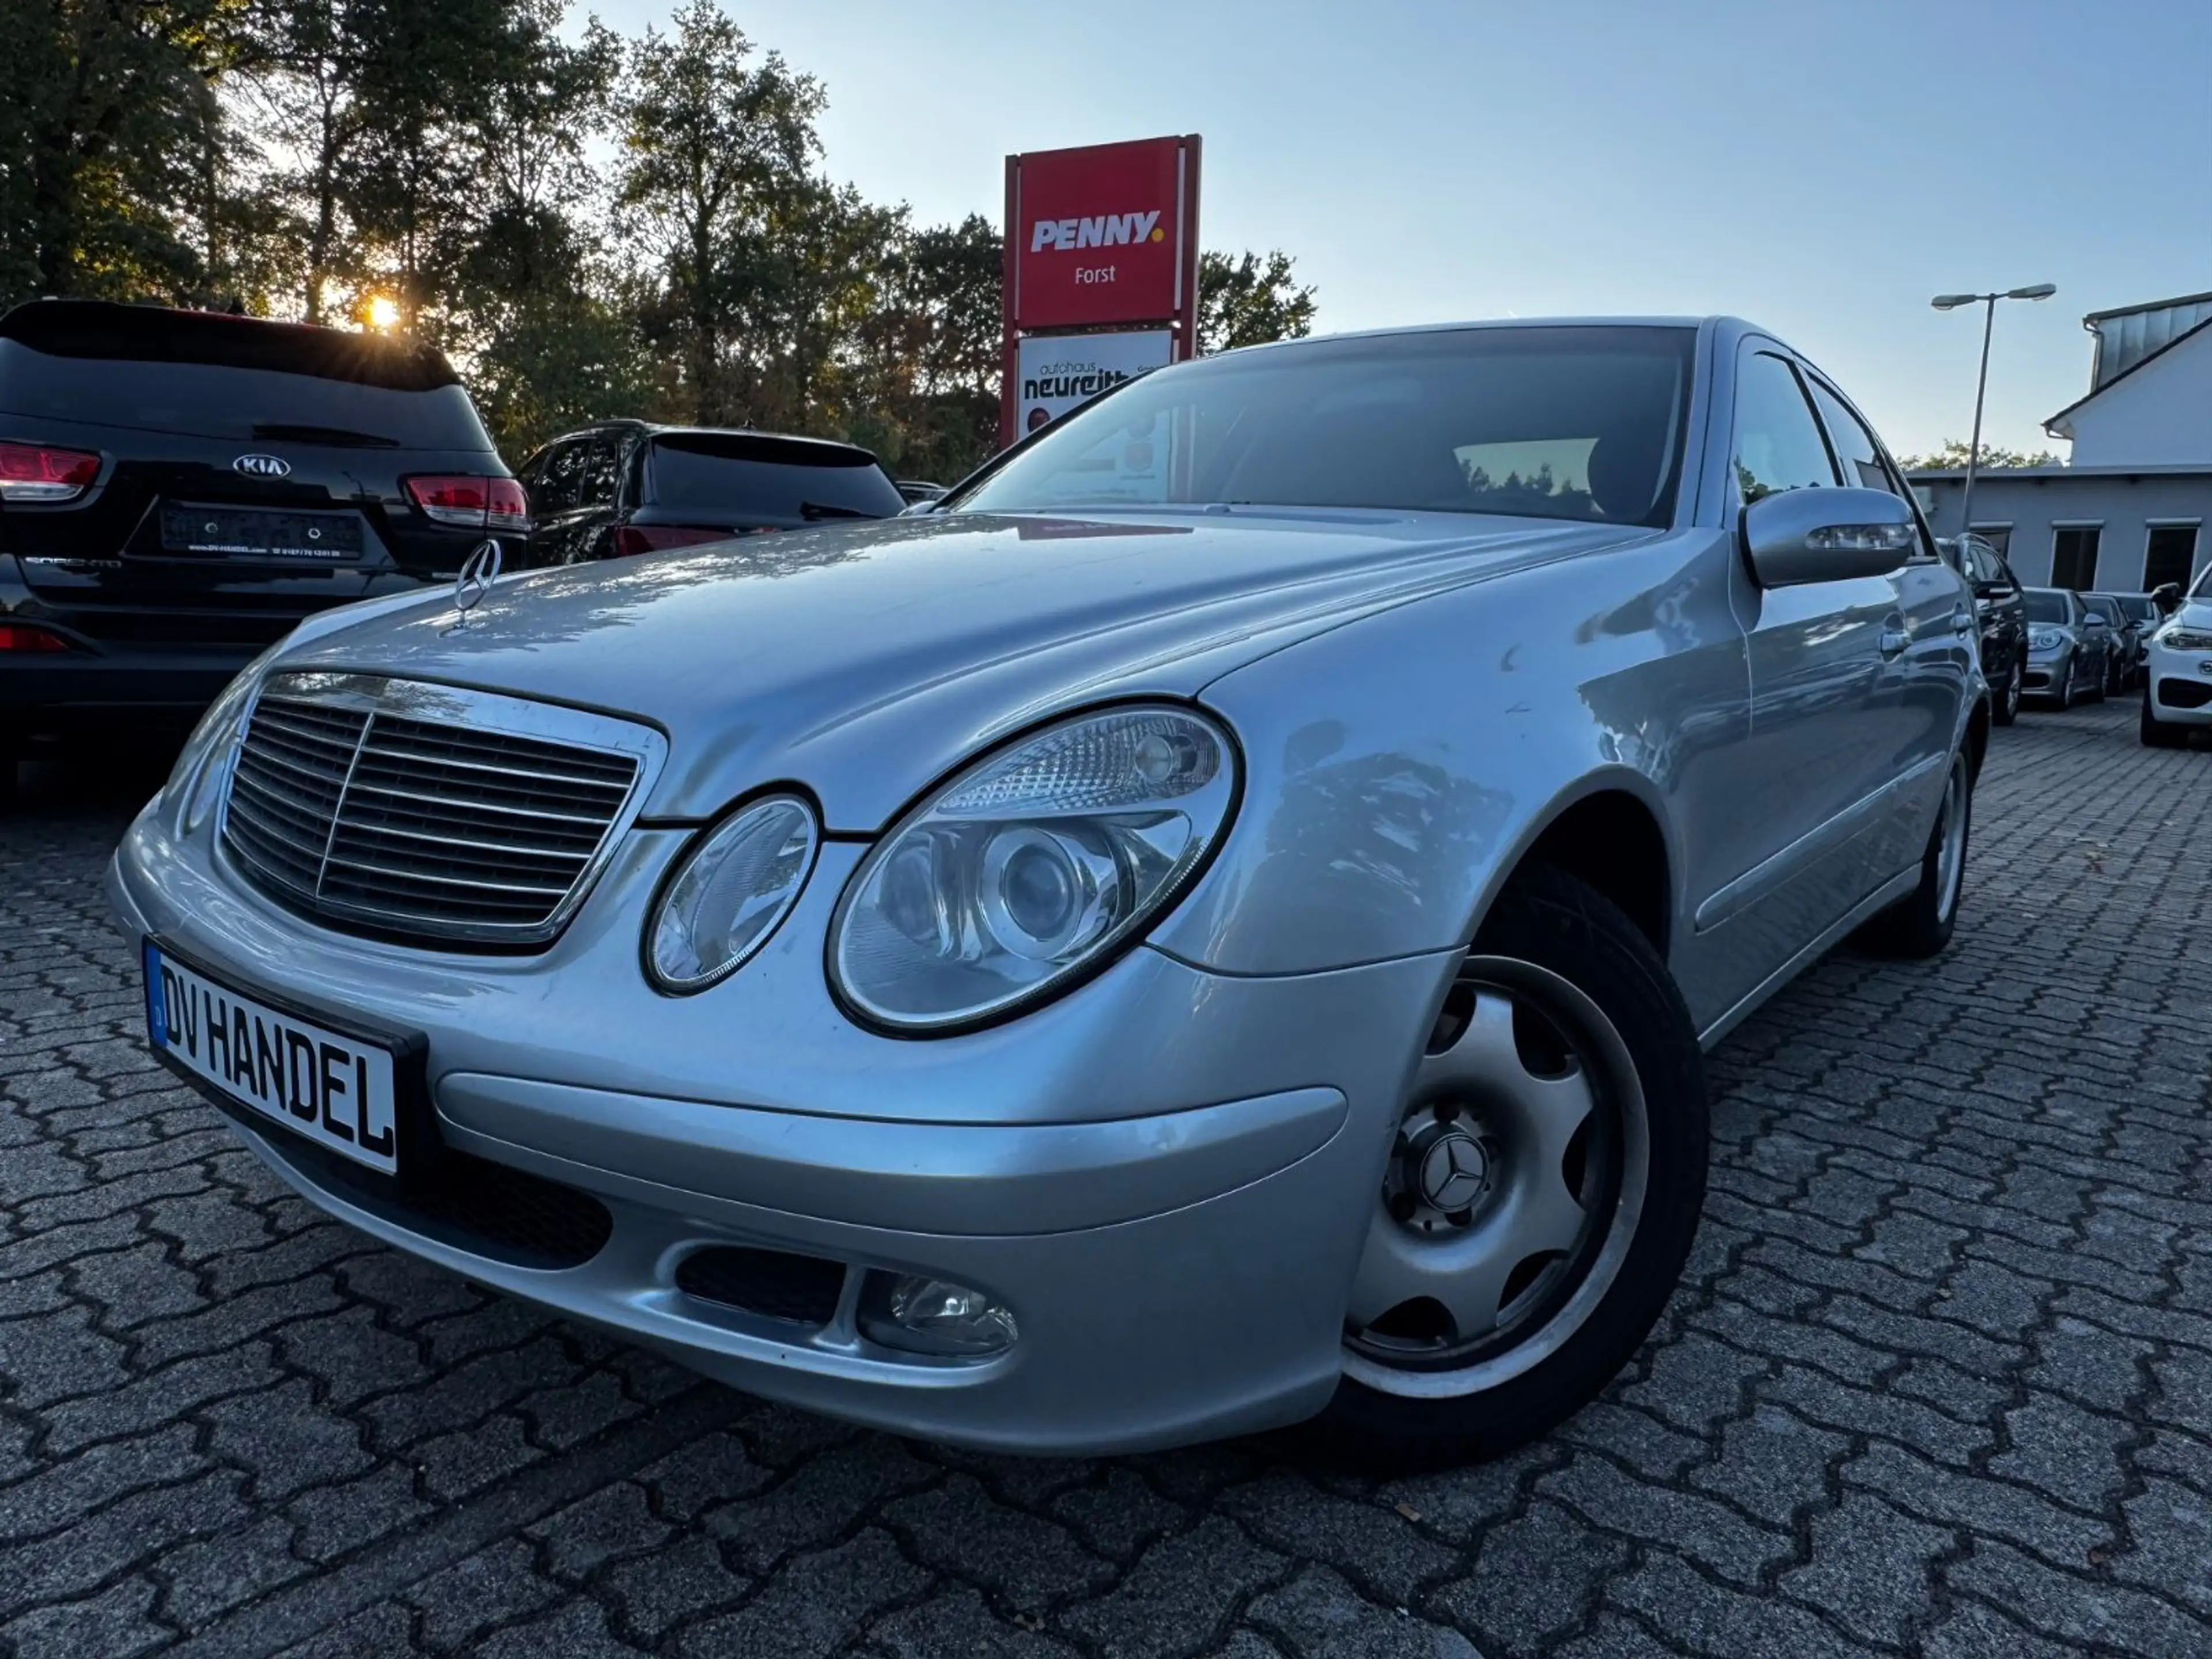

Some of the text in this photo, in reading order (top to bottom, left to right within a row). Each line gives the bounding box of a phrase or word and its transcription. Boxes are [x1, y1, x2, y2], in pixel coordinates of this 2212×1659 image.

[1075, 265, 1116, 284] Forst
[1040, 362, 1096, 375] autohaus
[243, 459, 282, 475] KIA
[161, 964, 394, 1157] DV HANDEL
